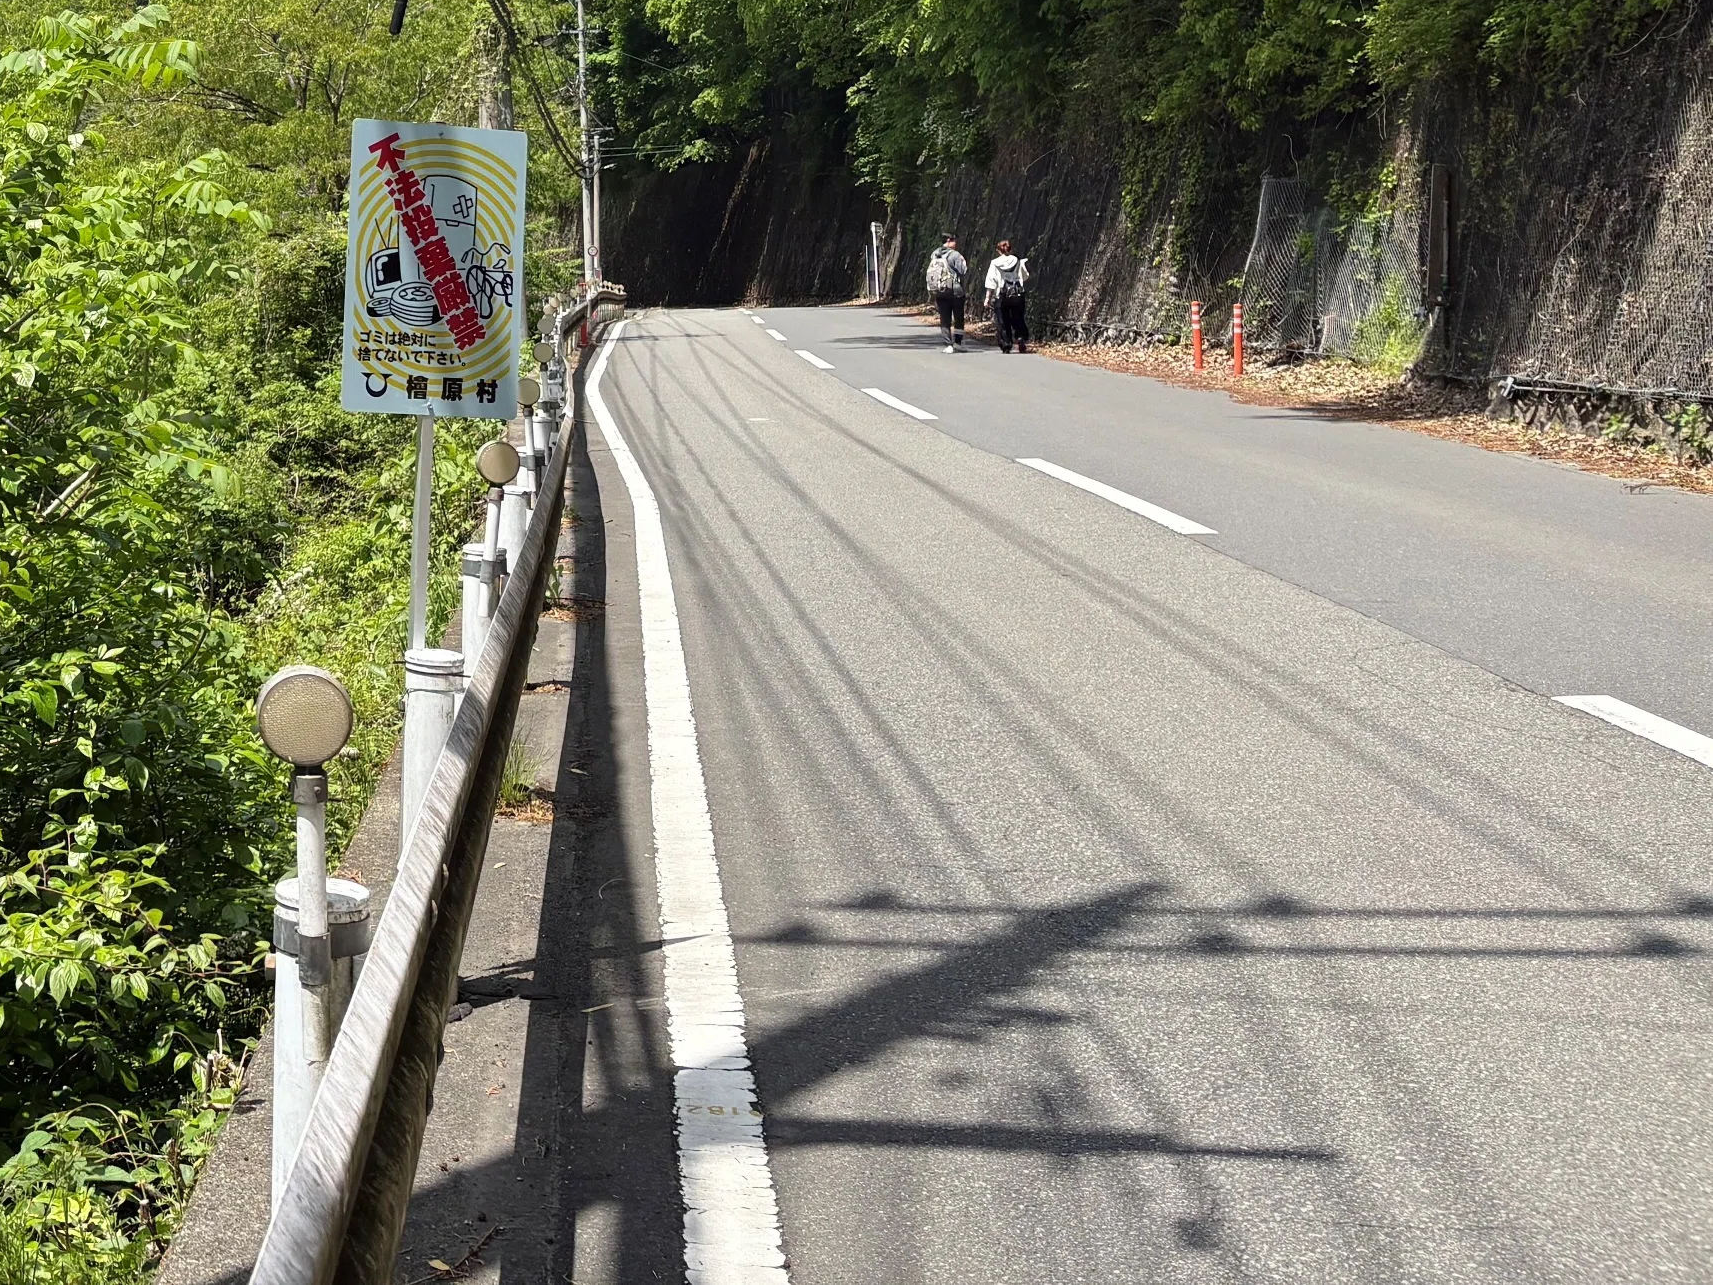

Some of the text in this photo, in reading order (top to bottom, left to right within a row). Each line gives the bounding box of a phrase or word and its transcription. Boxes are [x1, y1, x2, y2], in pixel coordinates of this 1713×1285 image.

[368, 132, 486, 350] 不法投棄厳禁
[360, 329, 436, 347] ゴミは絶対に
[357, 346, 466, 366] 捨てないで下さい。
[405, 374, 498, 404] 檜原村
